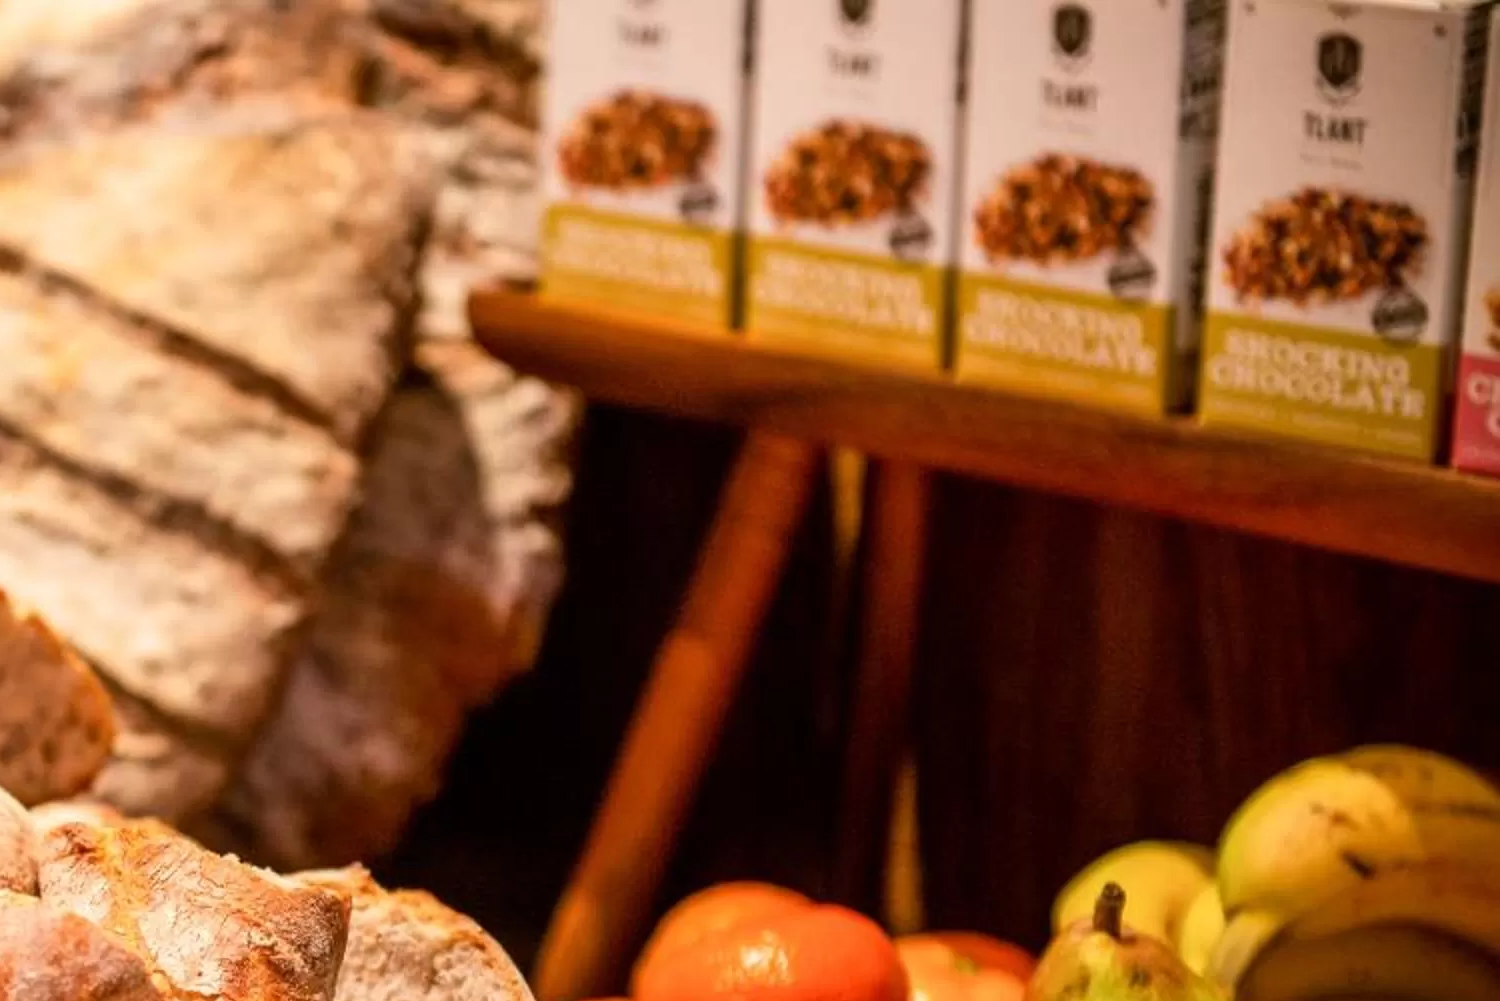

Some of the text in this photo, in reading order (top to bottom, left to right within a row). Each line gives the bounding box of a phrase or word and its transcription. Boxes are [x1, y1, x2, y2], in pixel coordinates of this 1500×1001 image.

[1303, 110, 1367, 144] TLANT
[963, 315, 1157, 377] CHOCOLATE
[1225, 329, 1409, 385] SHOCKING
[1209, 354, 1426, 420] CHOCOLATE
